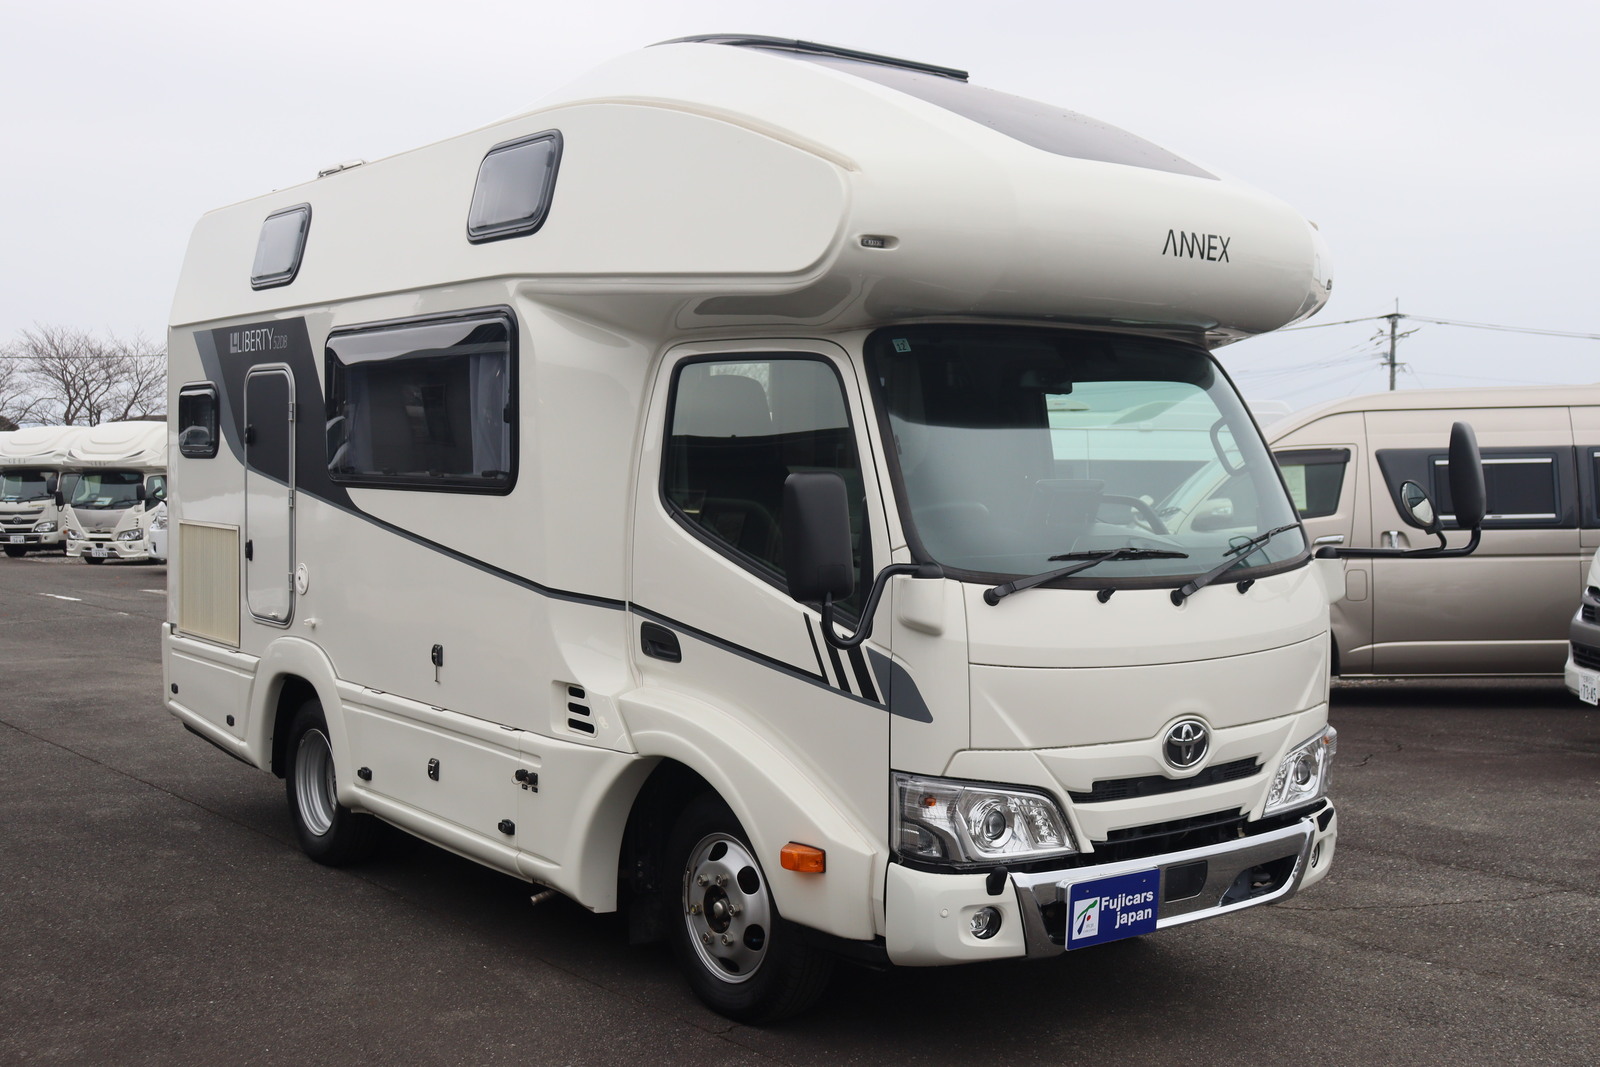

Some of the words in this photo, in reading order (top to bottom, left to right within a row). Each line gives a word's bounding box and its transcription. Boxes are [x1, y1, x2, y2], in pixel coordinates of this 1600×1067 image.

[1162, 229, 1231, 263] ANNEX
[237, 328, 274, 353] LIBERTY
[1101, 891, 1154, 911] Fujicars
[1115, 908, 1152, 929] japan
